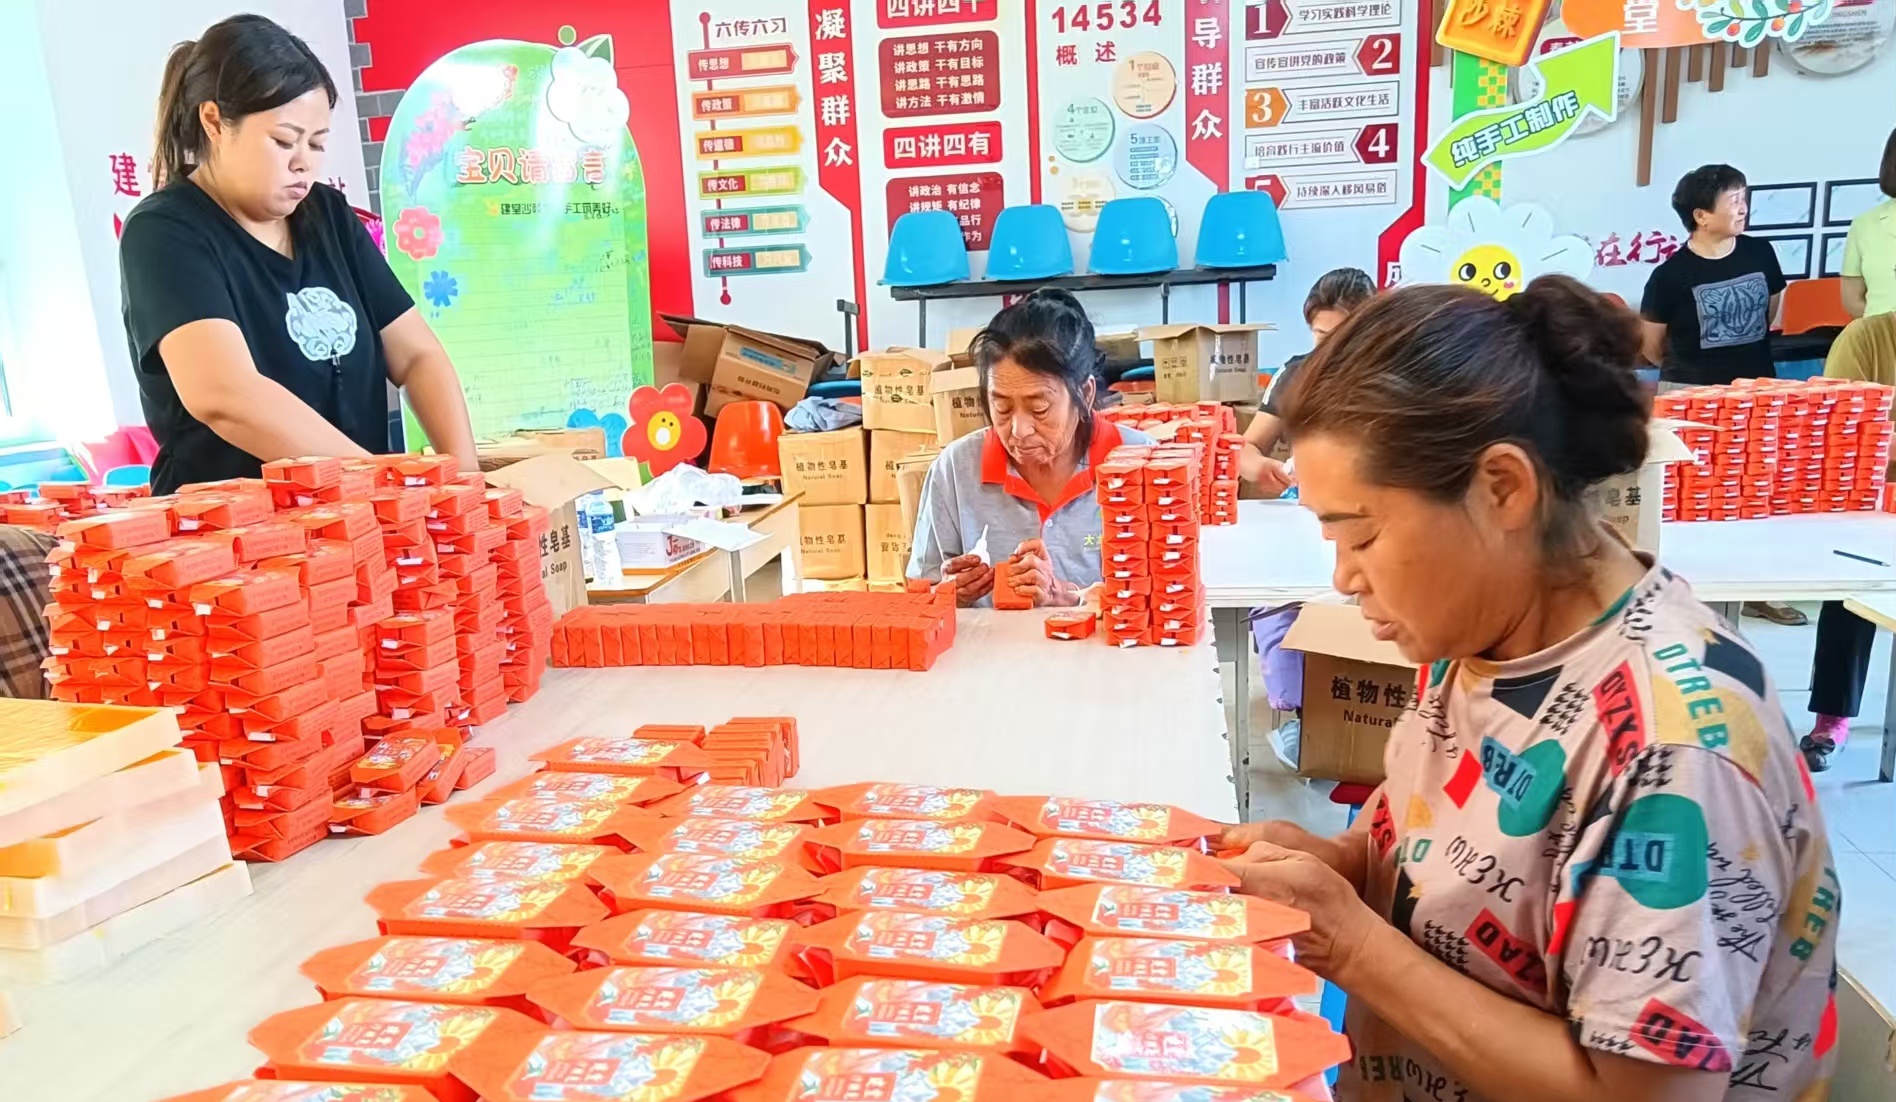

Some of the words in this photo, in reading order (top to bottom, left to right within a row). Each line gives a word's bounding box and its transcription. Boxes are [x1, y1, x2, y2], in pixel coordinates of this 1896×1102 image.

[1052, 0, 1162, 33] 14534
[1252, 1, 1272, 34] 1
[1299, 3, 1392, 21] 学习实践科学理论
[715, 17, 787, 38] 六传六习
[893, 42, 929, 56] 讲思想
[1056, 41, 1117, 66] 概述
[1371, 38, 1393, 70] 2
[698, 57, 730, 72] 传思想
[894, 60, 930, 74] 讲政策
[1191, 0, 1224, 141] 导群众
[814, 8, 853, 167] 凝聚群众
[895, 78, 931, 91] 讲思路
[896, 95, 932, 109] 讲方法
[1252, 92, 1273, 123] 3
[1299, 93, 1390, 111] 丰富活跃文化生活
[1450, 90, 1580, 168] 纯手工制作
[894, 131, 991, 159] 四讲四有
[1368, 128, 1390, 158] 4
[707, 178, 738, 192] 传文化
[908, 184, 942, 197] 讲政治
[946, 182, 981, 195] 有信念
[947, 198, 981, 212] 有纪律
[710, 217, 741, 231] 传法律
[957, 214, 981, 226] 品行
[711, 255, 743, 269] 传科技
[952, 396, 981, 409] 植物
[796, 460, 848, 472] 植物性皂基
[551, 561, 567, 575] Soap
[1331, 675, 1407, 709] 植物性
[1653, 643, 1729, 749] DTREB
